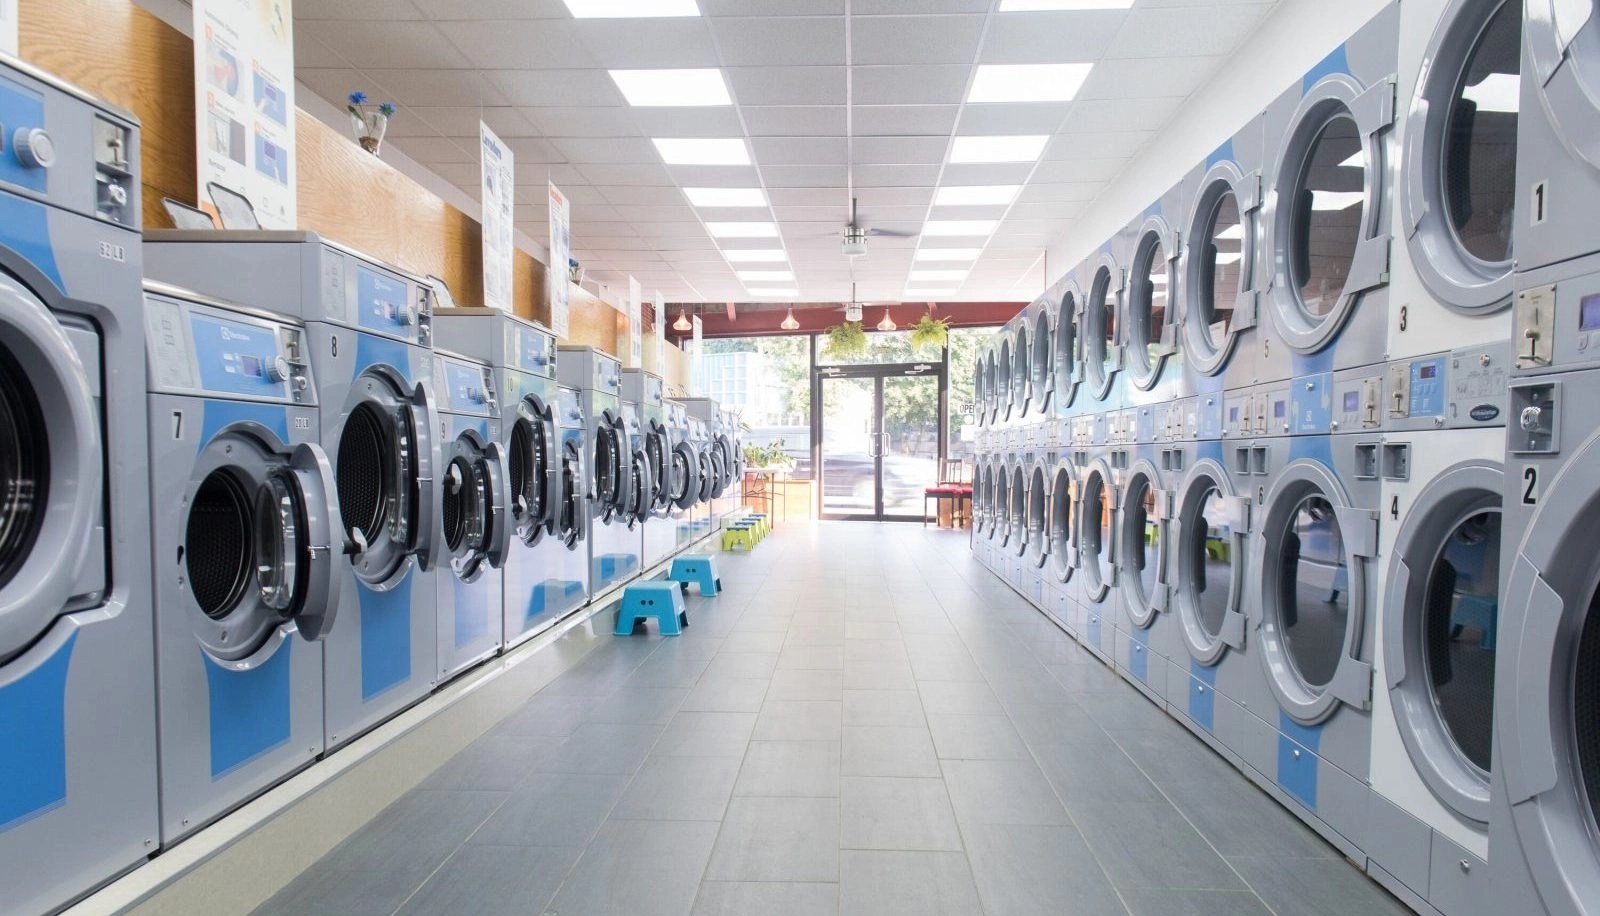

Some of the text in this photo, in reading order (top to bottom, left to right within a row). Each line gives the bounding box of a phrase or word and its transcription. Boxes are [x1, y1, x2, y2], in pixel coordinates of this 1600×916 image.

[1536, 183, 1544, 221] 1
[1400, 305, 1407, 331] 3
[331, 335, 337, 357] 8
[1264, 339, 1270, 359] 5
[960, 404, 975, 413] OPE
[173, 411, 182, 439] 7
[441, 422, 446, 440] 9
[1258, 486, 1264, 505] 6
[1523, 467, 1537, 504] 2
[1391, 495, 1399, 520] 4
